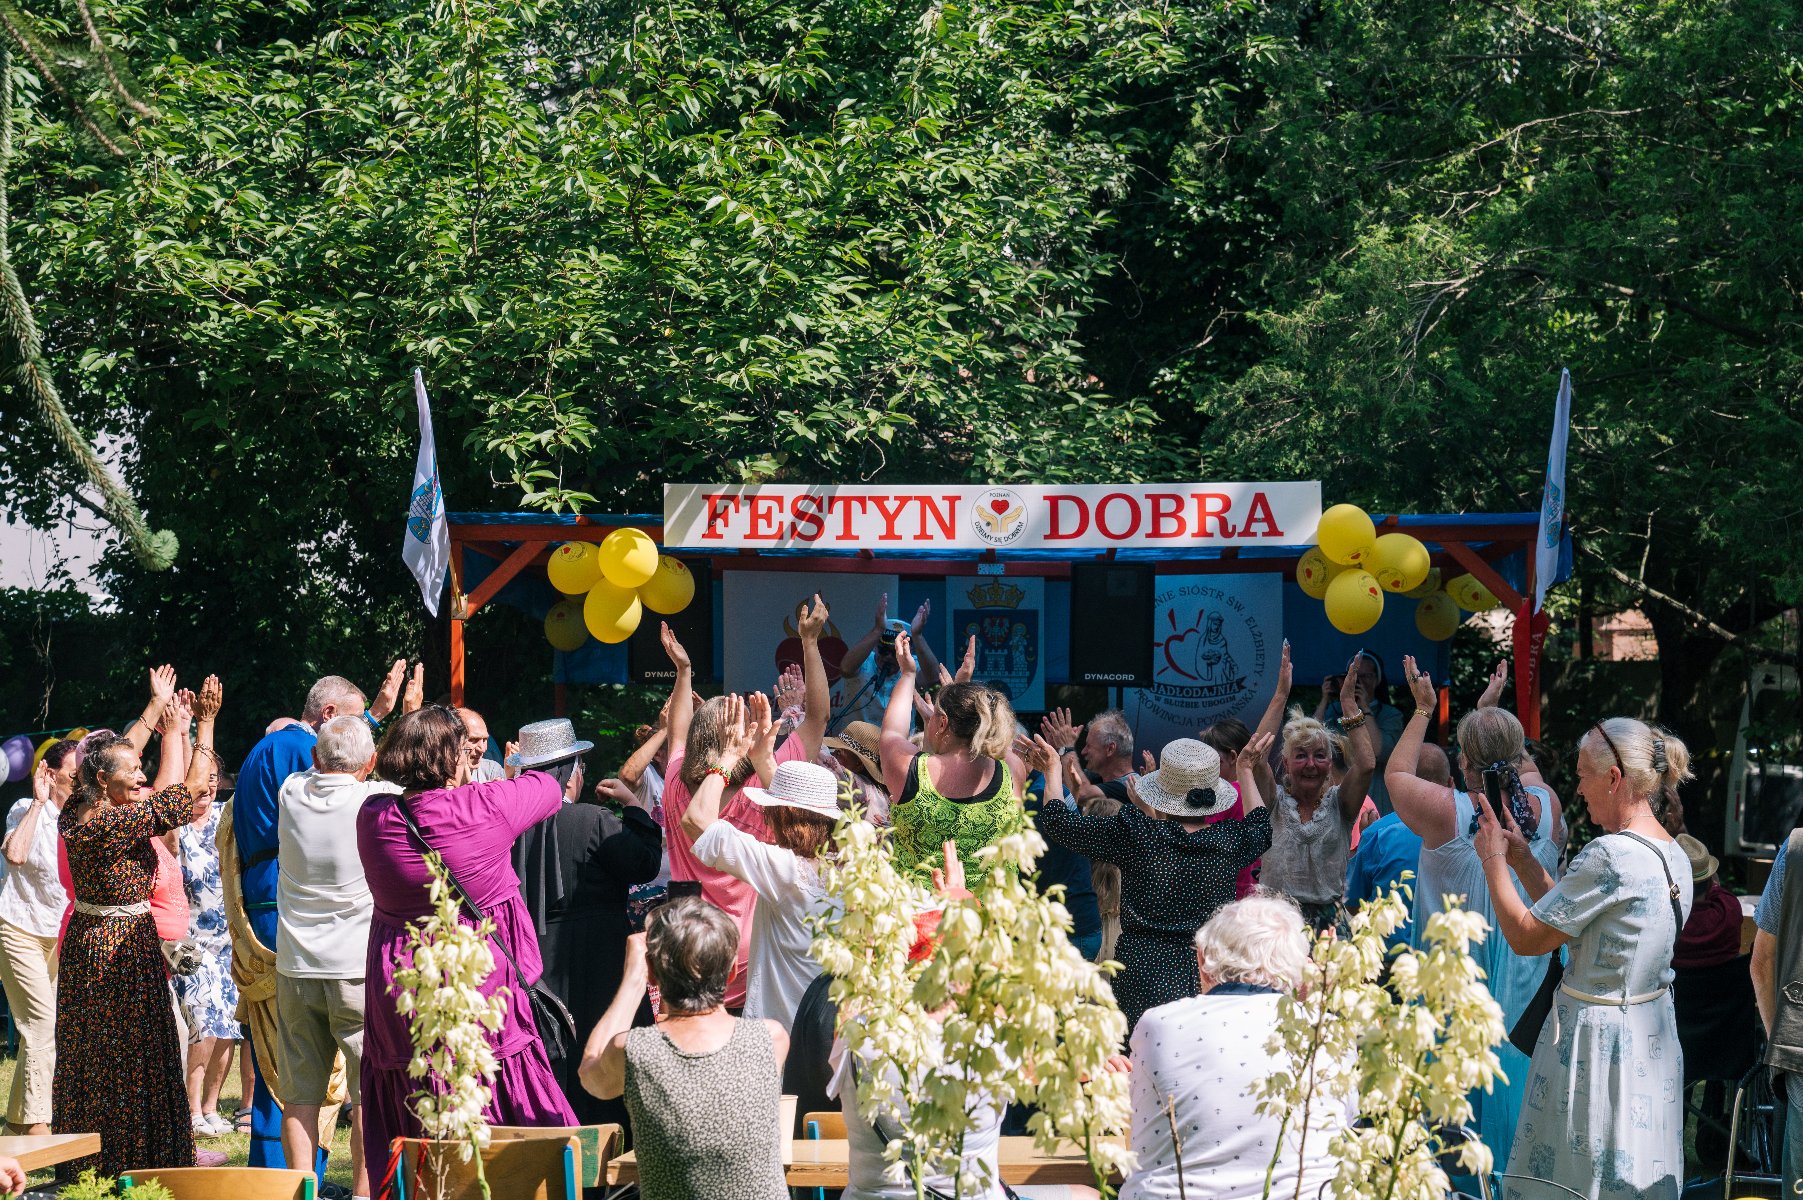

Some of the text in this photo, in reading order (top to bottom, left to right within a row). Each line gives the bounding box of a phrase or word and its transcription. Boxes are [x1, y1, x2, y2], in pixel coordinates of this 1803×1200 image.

[702, 492, 1284, 542] FESTYN DOBRA
[1003, 521, 1024, 542] DOBREM
[1178, 584, 1225, 600] SIÓSTR
[1245, 616, 1265, 677] ELŻBIETY
[1150, 681, 1240, 698] JADŁODAJNIA
[1164, 698, 1199, 709] SŁUŻBIE
[1202, 695, 1236, 708] UBOGIM
